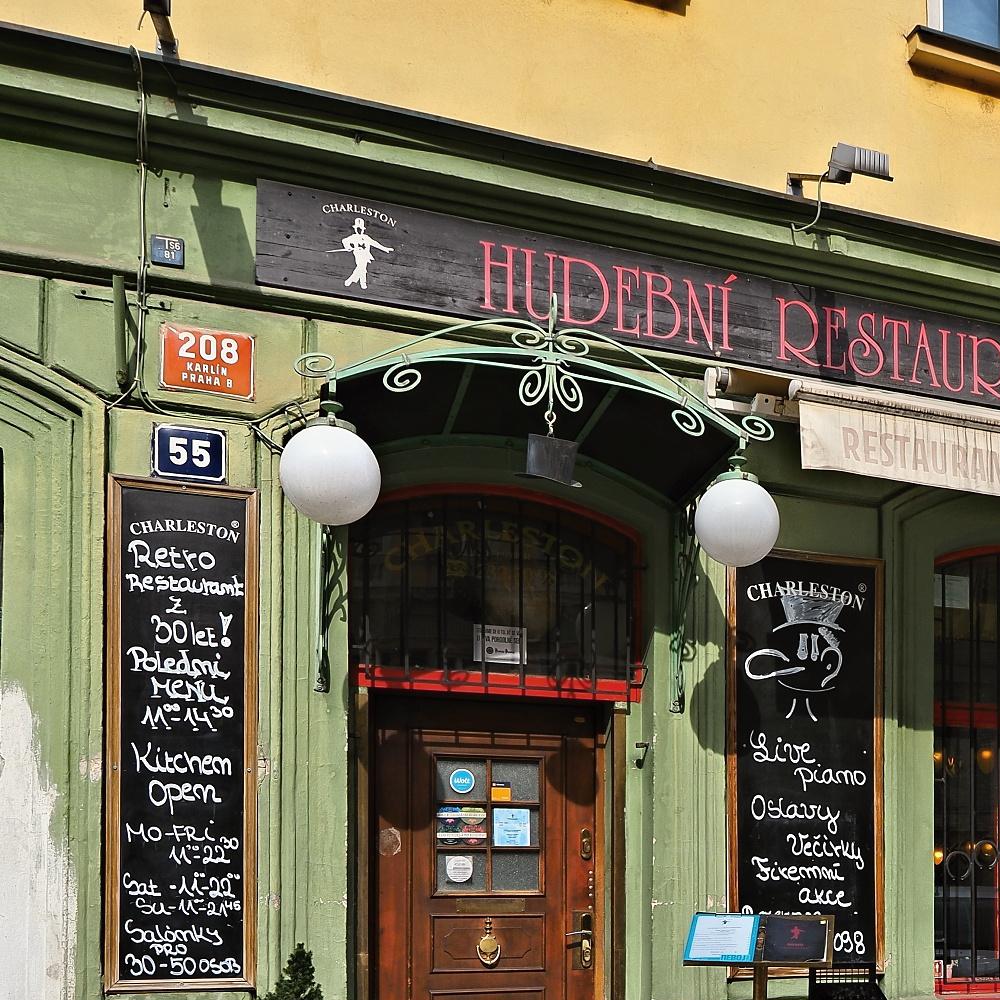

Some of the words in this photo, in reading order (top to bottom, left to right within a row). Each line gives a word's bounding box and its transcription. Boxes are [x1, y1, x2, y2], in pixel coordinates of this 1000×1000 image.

[322, 204, 397, 227] CHARLESTON
[164, 250, 175, 260] 81
[479, 240, 738, 351] HUDEBNÍ
[178, 331, 239, 364] 208
[181, 372, 221, 387] PRAHA
[186, 361, 228, 377] KARLÍN
[169, 436, 211, 468] 55
[127, 540, 216, 572] Retro
[151, 615, 188, 643] 30
[131, 742, 232, 776] Kitchen
[750, 730, 816, 763] Live
[794, 764, 867, 791] piano
[149, 779, 222, 815] Open
[751, 794, 841, 834] Oslavy
[798, 887, 852, 907] akce
